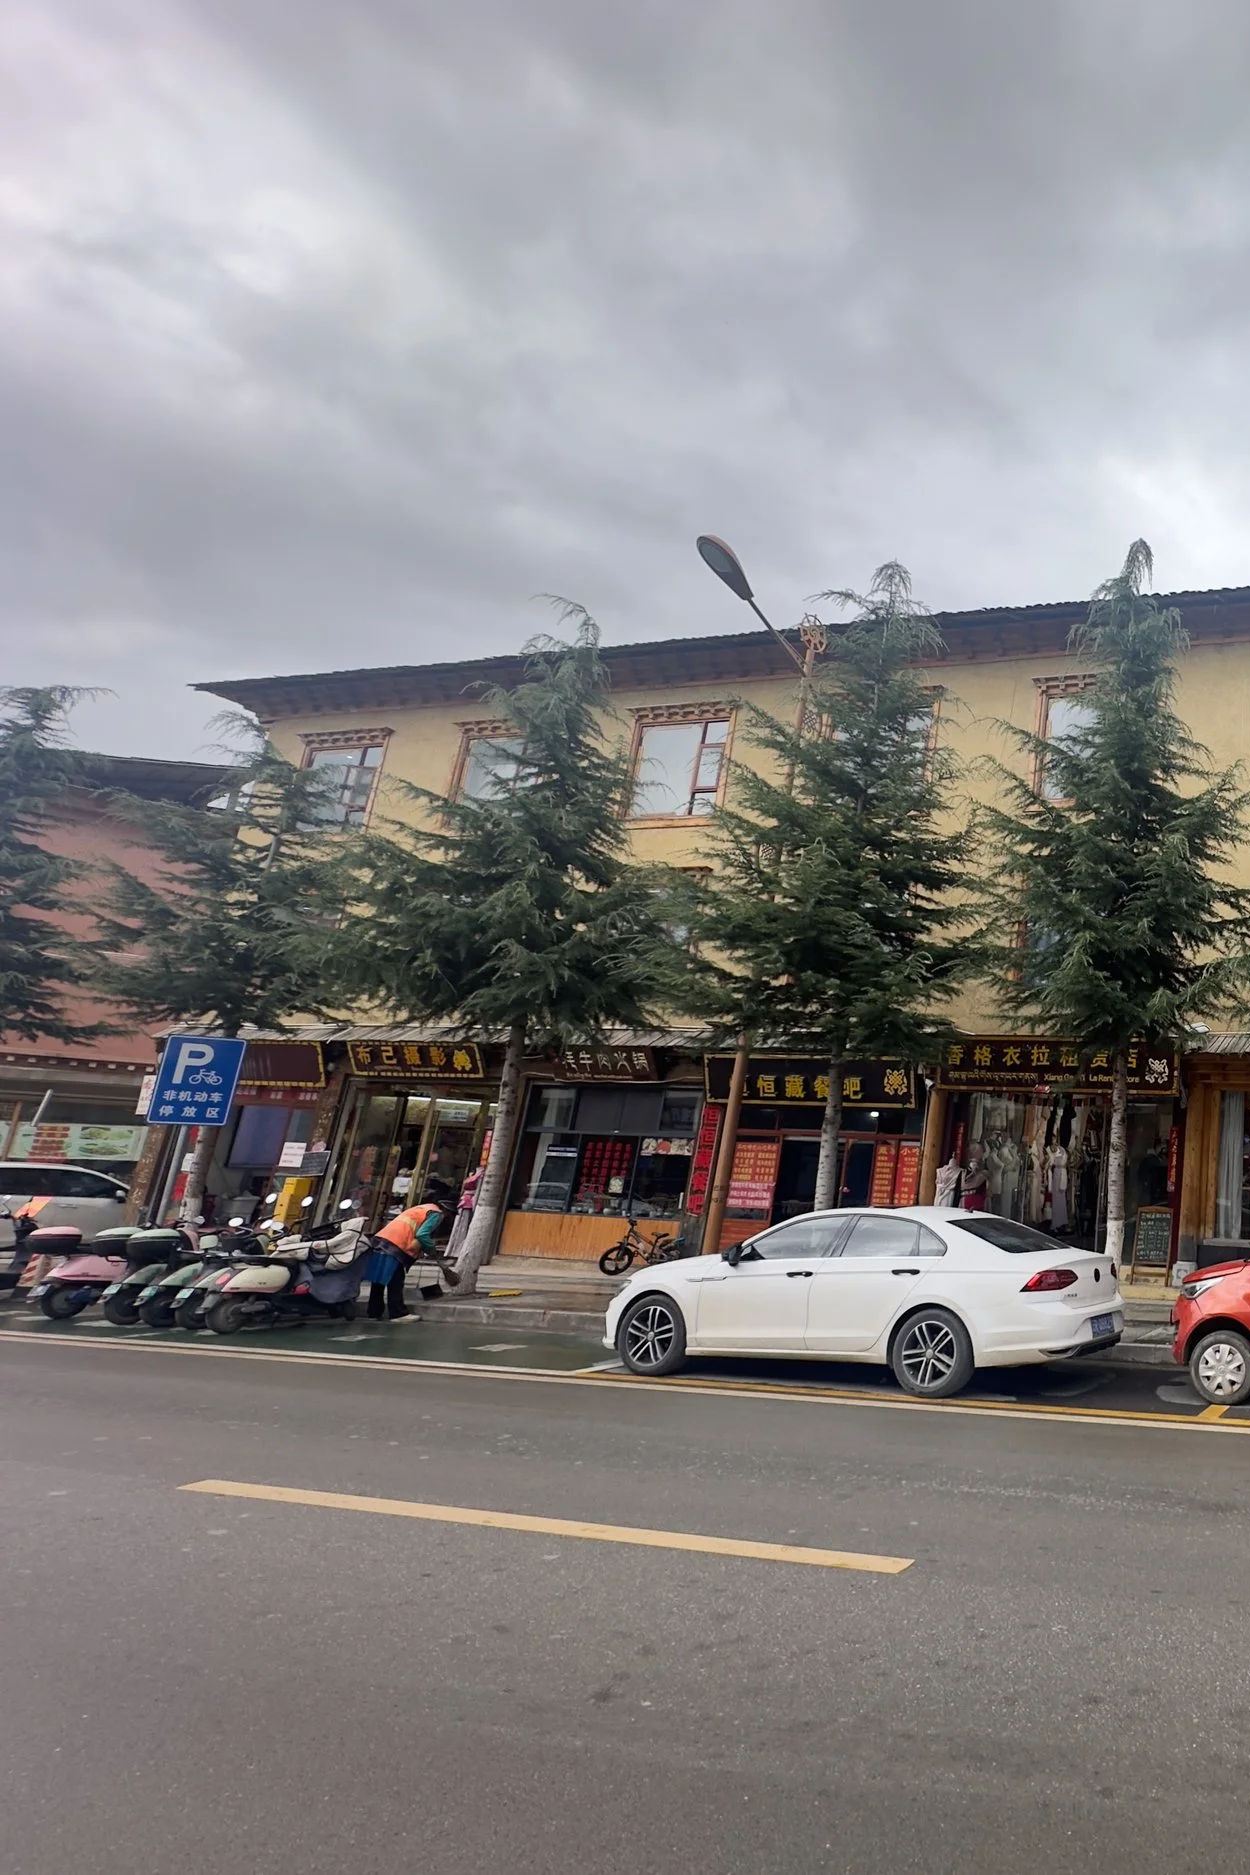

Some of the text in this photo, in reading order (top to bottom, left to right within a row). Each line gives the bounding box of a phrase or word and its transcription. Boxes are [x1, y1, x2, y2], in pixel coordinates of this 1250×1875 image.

[172, 1043, 214, 1084] P
[163, 1089, 223, 1103] 非机动车
[729, 1074, 863, 1100] 恒藏餐吧
[159, 1105, 221, 1118] 停放区
